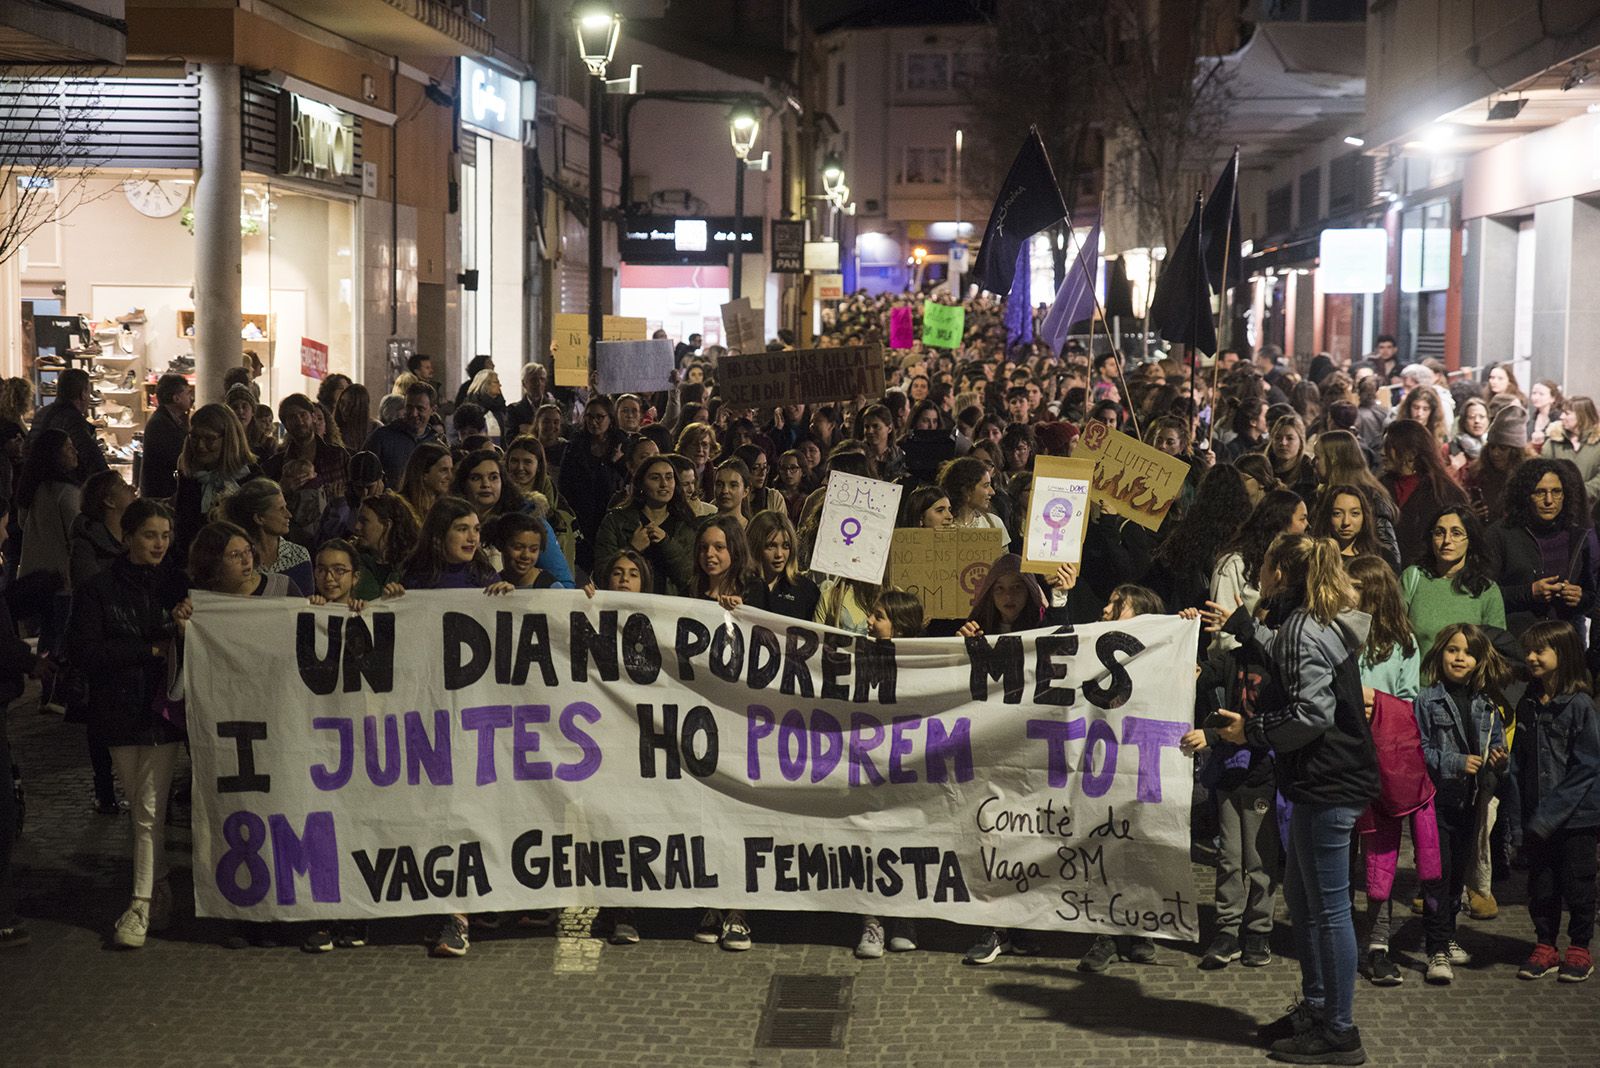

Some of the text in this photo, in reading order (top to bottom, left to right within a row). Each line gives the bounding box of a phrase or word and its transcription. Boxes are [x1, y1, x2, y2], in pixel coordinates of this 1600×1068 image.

[1103, 440, 1172, 487] LLUITEM
[894, 550, 913, 564] NO
[925, 550, 951, 562] ENS
[961, 531, 1000, 542] DONES
[924, 569, 959, 581] VIDA
[295, 610, 1146, 709] UN DIA NO PODREM MÉS
[216, 701, 1191, 803] I JUNTES HO PODREM TOT
[976, 797, 1133, 840] Comitè de
[215, 811, 341, 908] 8M
[351, 841, 493, 903] VAGA
[511, 829, 718, 891] GENERAL
[980, 845, 1108, 893] Vaga 8M
